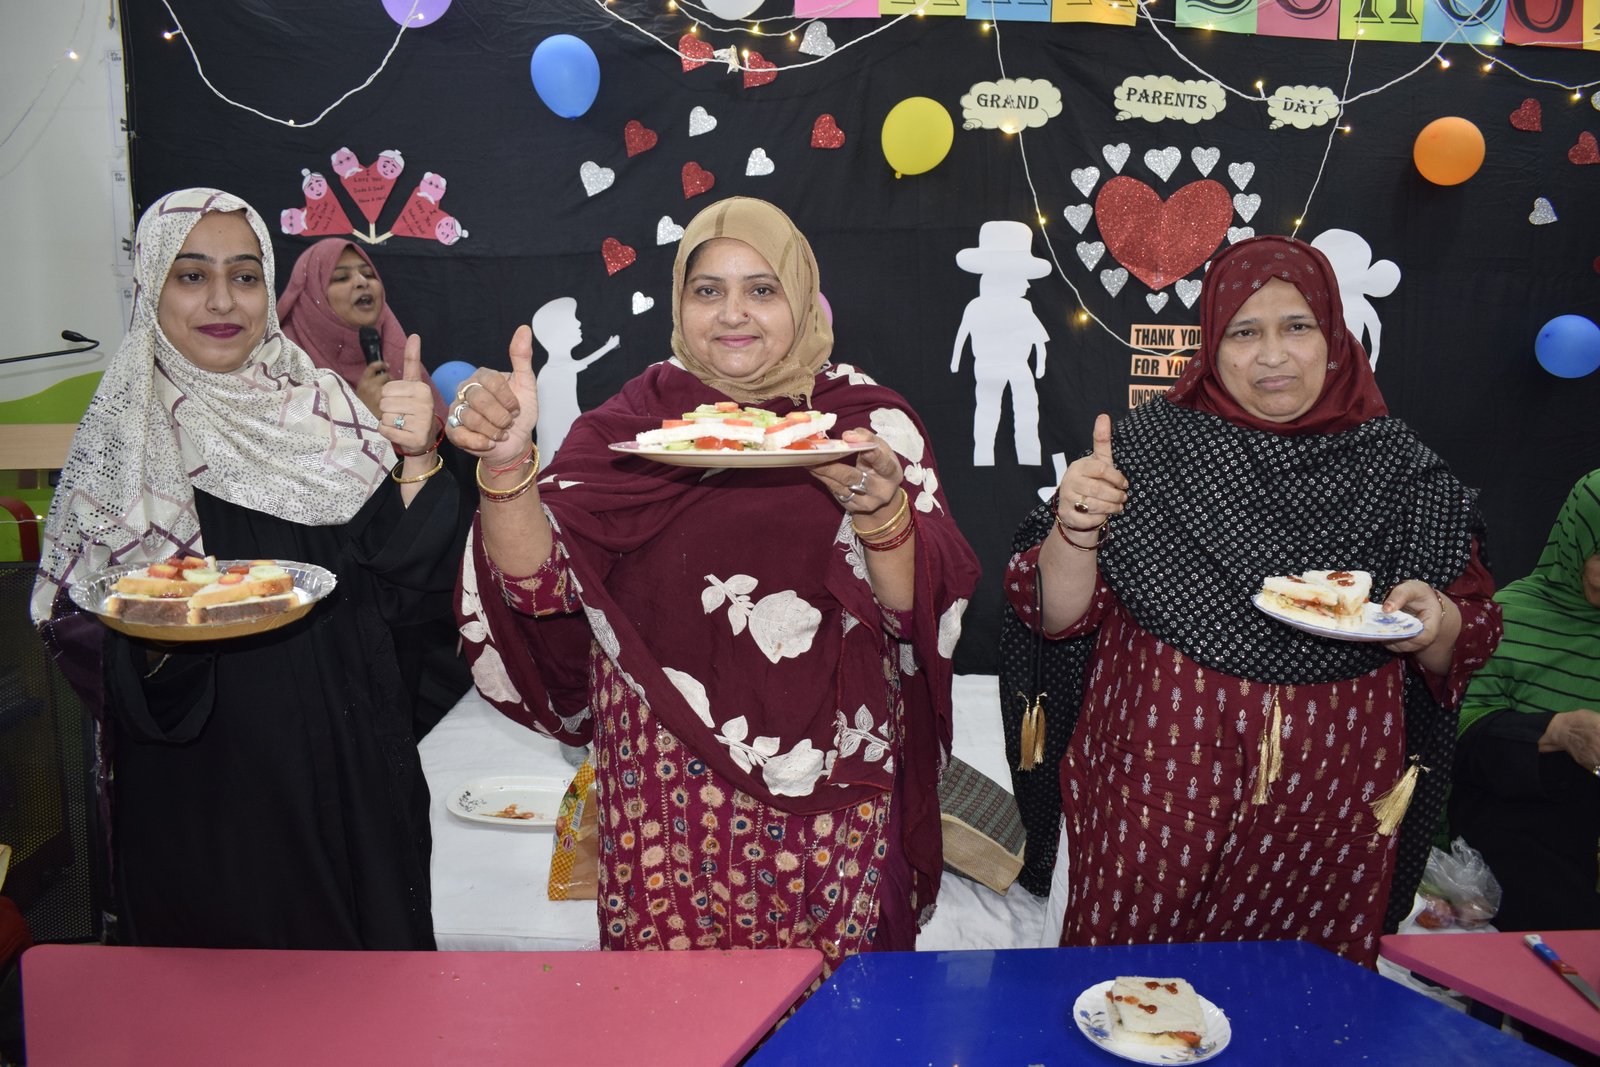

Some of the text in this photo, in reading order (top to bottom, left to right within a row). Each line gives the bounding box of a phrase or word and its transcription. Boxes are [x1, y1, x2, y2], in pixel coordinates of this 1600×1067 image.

[976, 93, 1039, 110] GRAND
[1126, 87, 1207, 109] PARENTS
[1283, 97, 1323, 114] DAY
[1134, 328, 1175, 346] THANK
[1133, 358, 1160, 375] FOR
